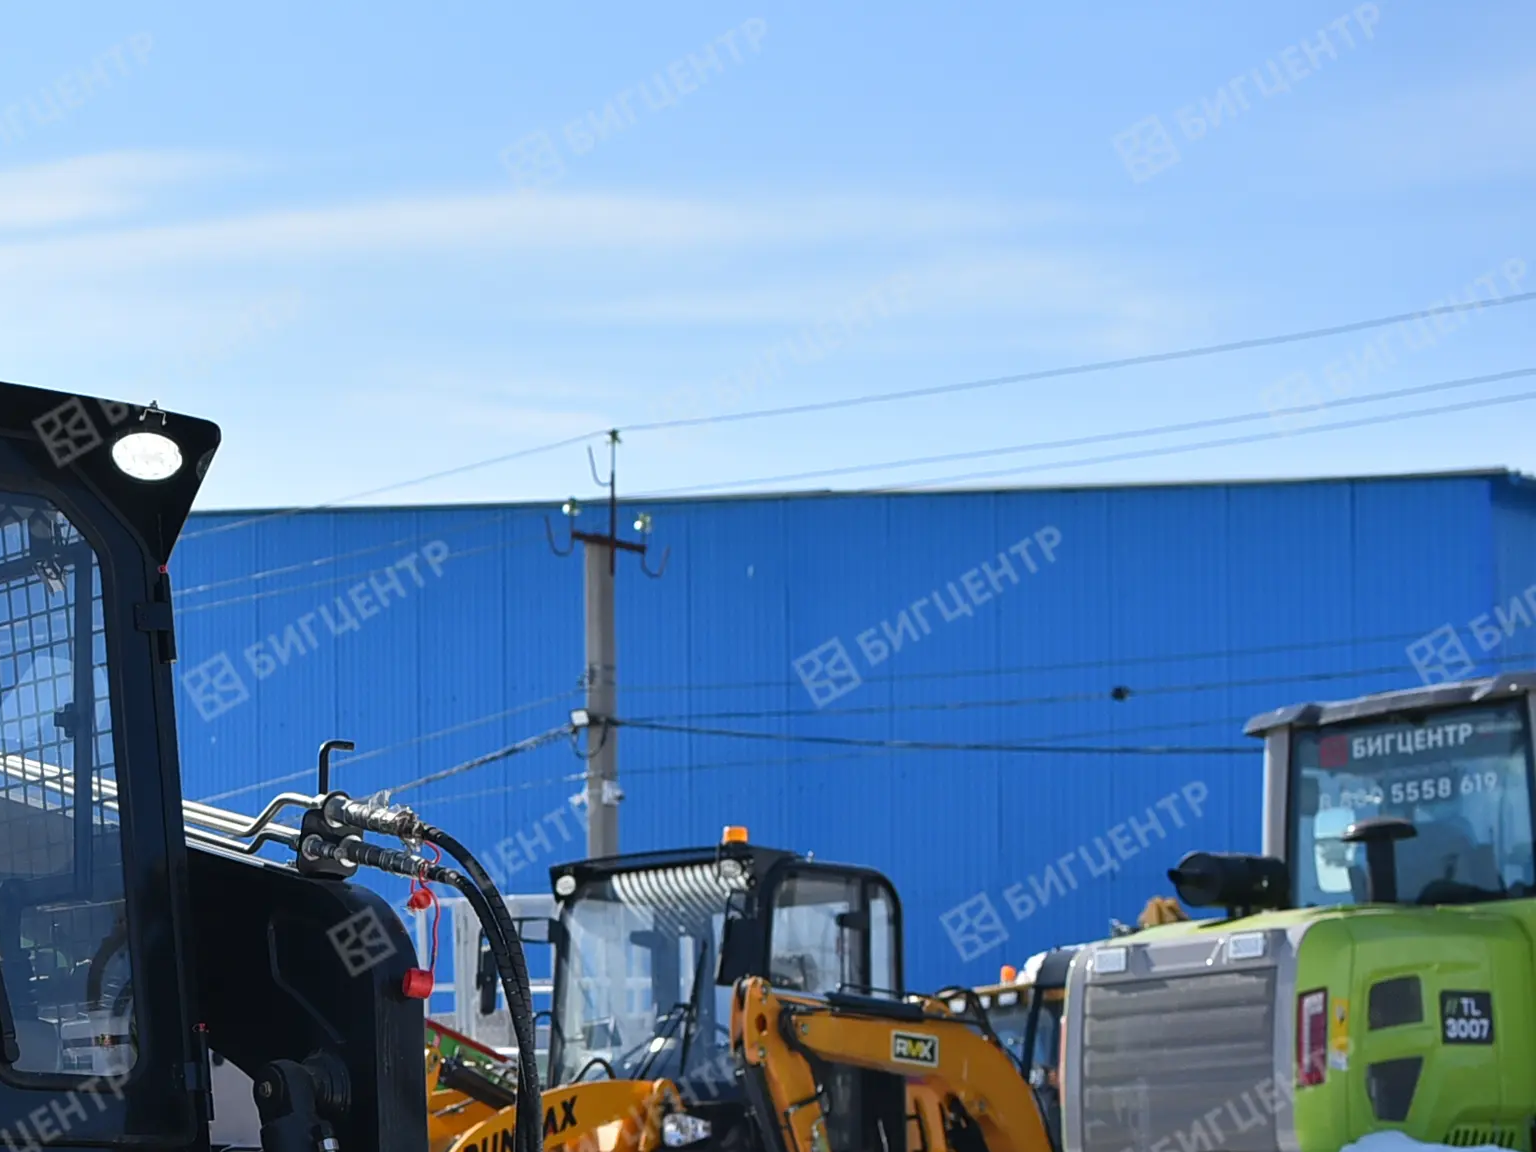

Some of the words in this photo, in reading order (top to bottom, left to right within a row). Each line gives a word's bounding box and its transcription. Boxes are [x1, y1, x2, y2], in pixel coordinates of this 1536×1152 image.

[1352, 723, 1473, 759] БИГЦЕНТР
[1391, 777, 1452, 804] 5558
[1460, 771, 1498, 795] 619
[1460, 997, 1482, 1016] TL
[1445, 1018, 1490, 1040] 3007
[895, 1038, 933, 1060] RMX
